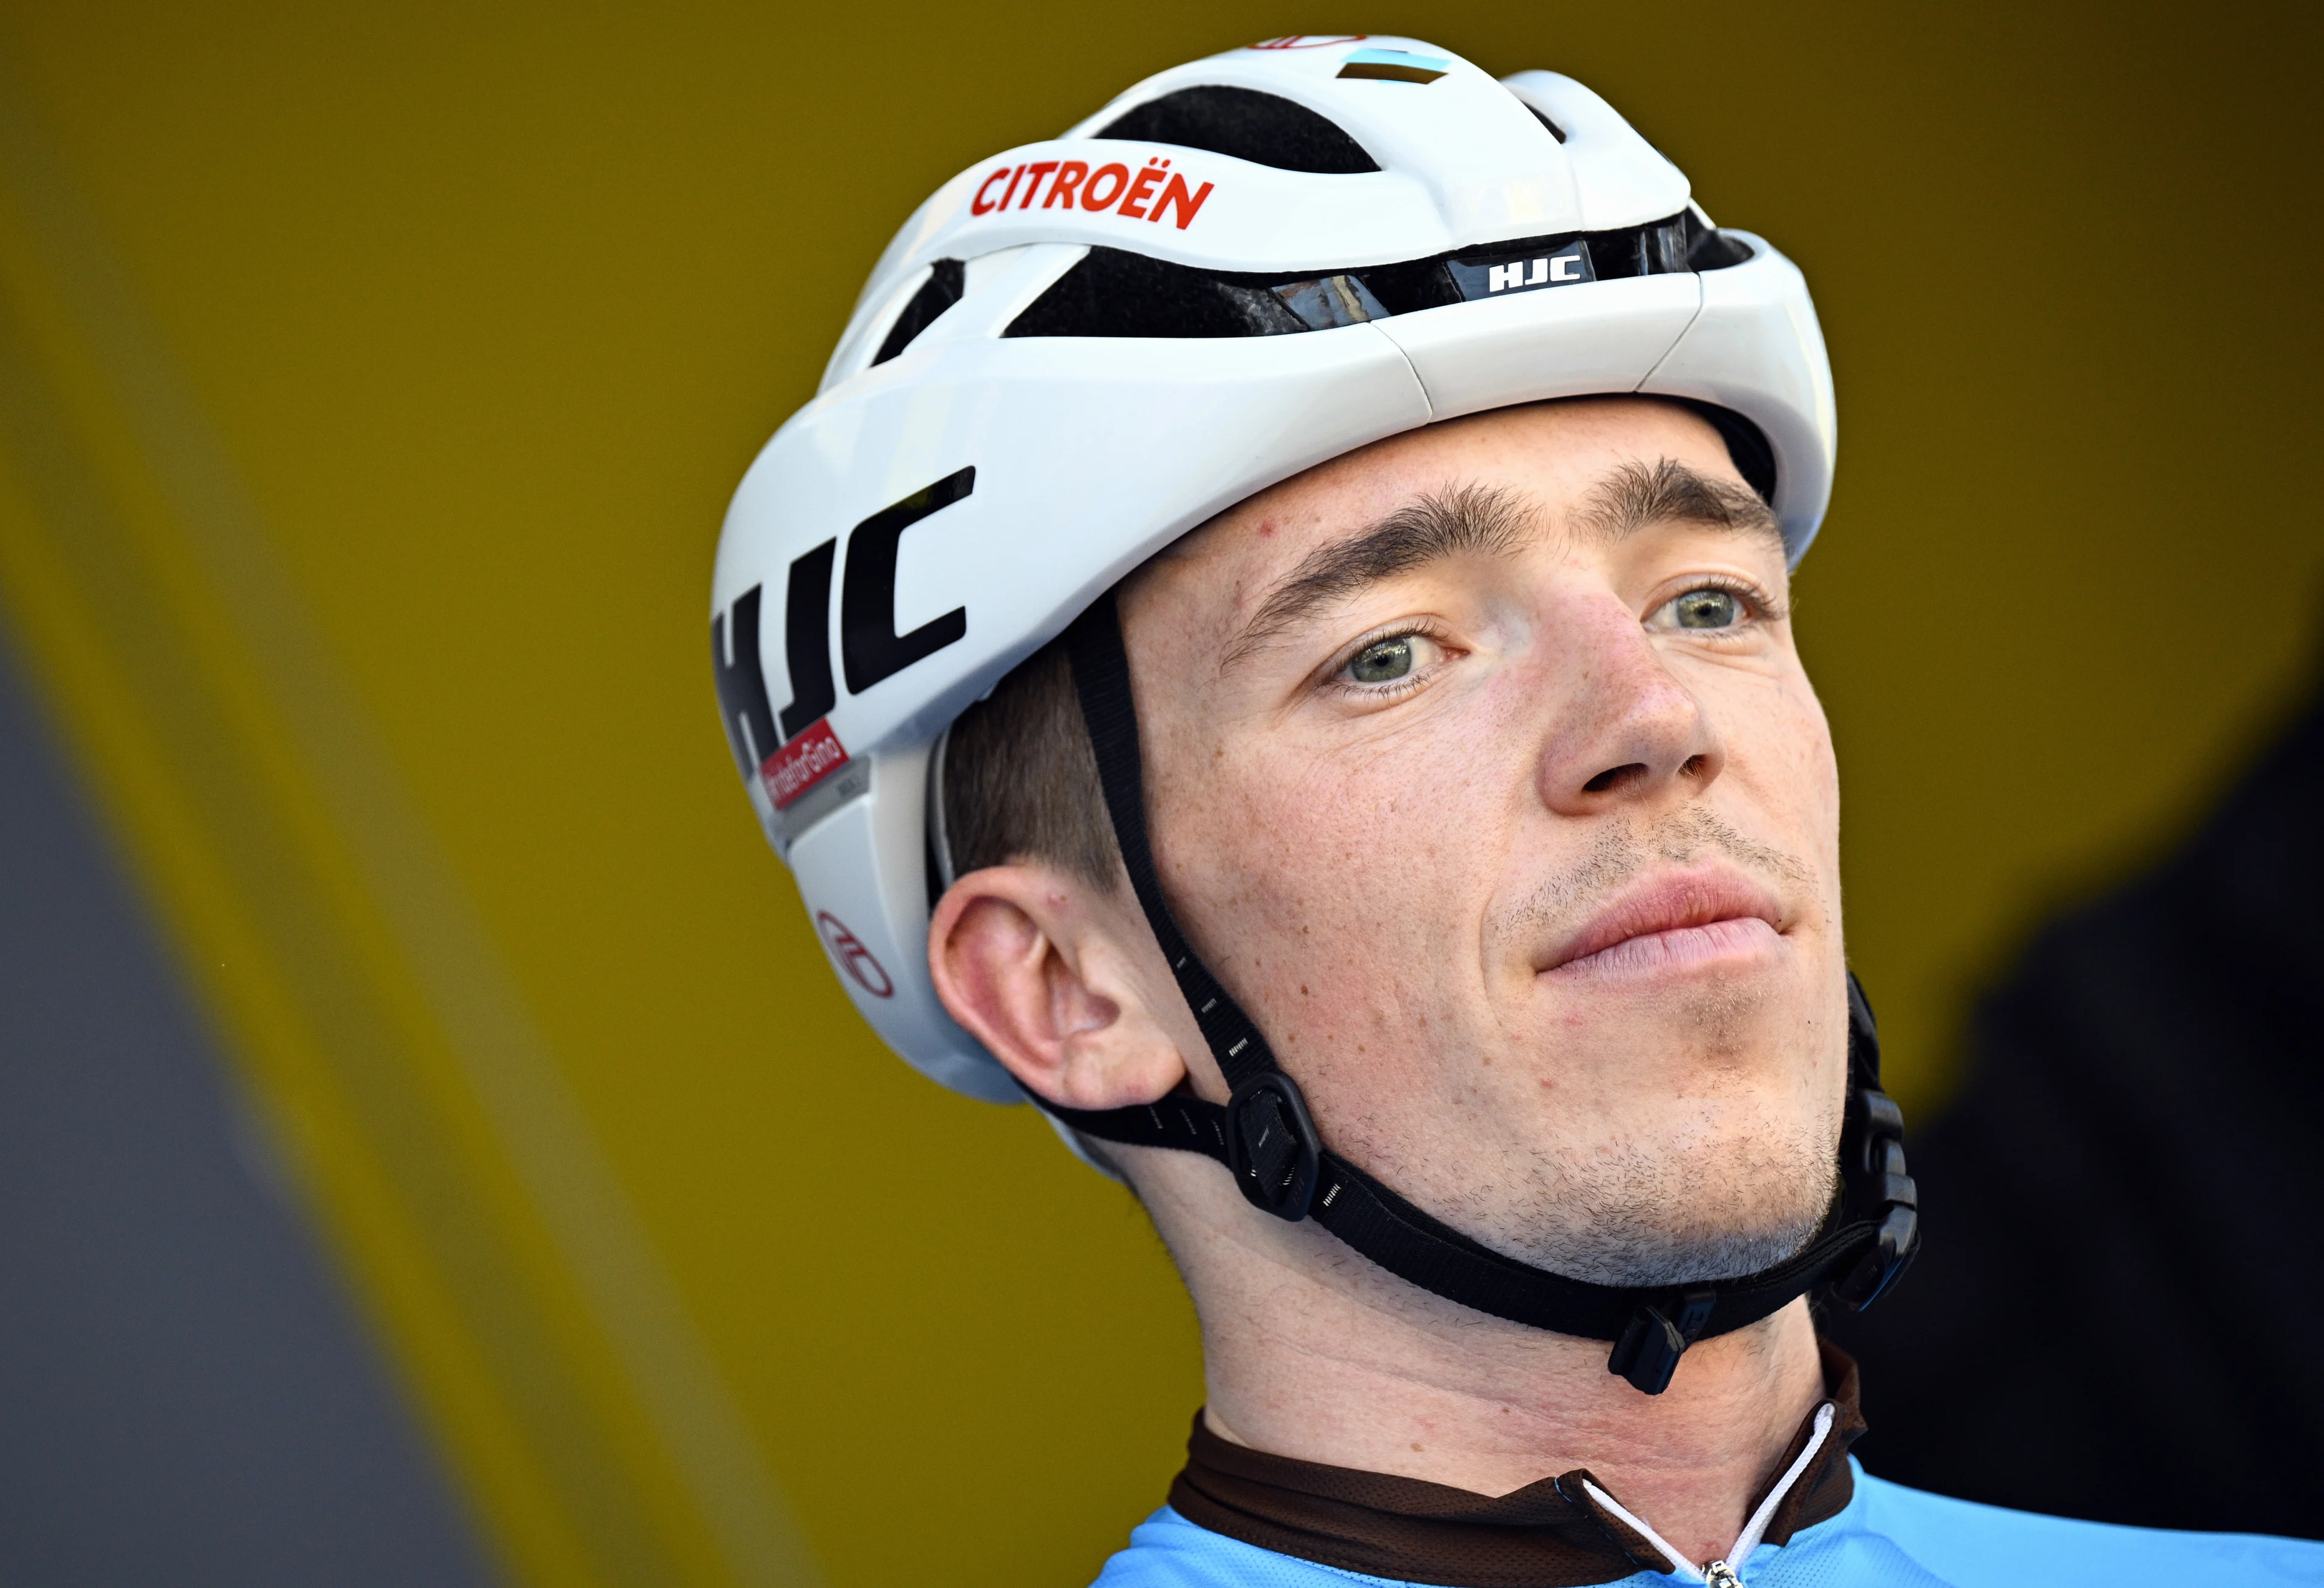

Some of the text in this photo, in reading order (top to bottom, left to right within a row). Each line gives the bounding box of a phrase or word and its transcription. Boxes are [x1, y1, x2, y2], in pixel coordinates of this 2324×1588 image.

[970, 156, 1215, 231] CITROËN
[1489, 255, 1581, 292] HJC
[711, 465, 976, 781] HJC
